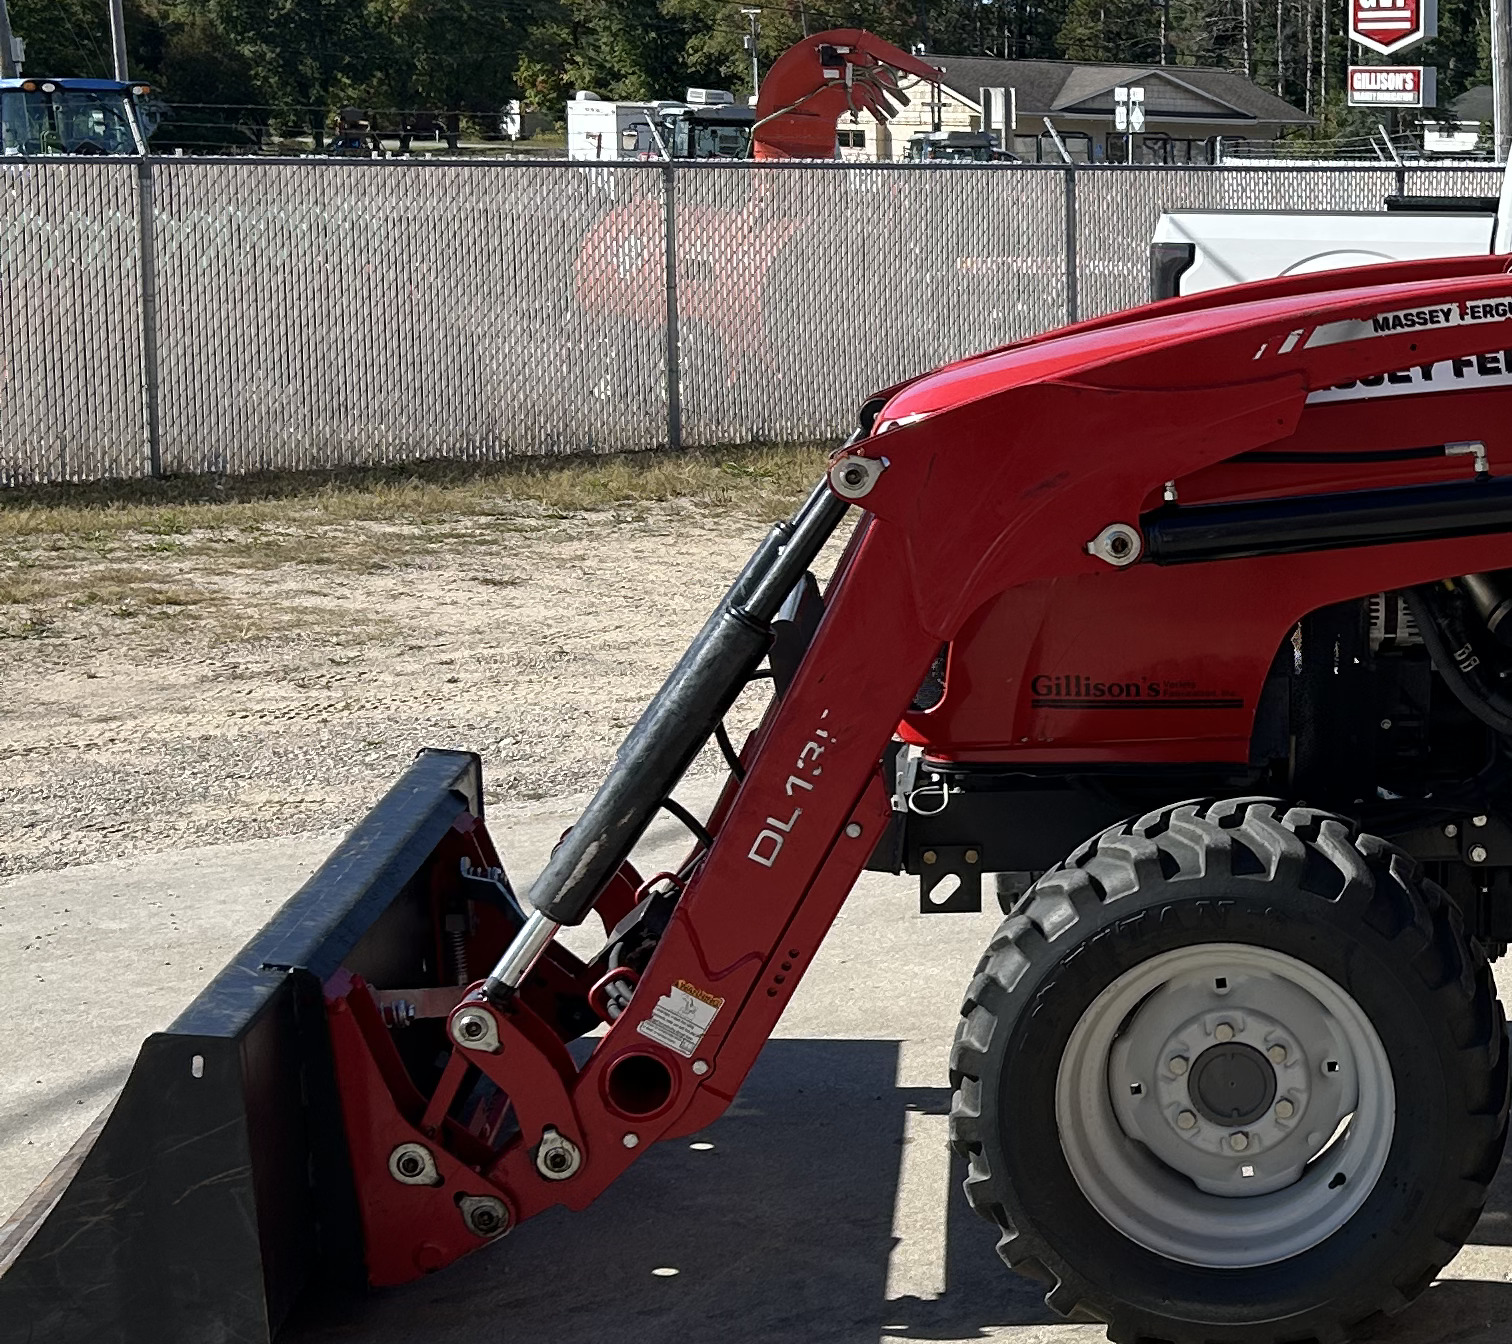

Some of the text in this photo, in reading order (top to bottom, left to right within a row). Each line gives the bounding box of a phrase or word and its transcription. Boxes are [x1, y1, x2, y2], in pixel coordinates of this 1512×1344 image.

[1352, 72, 1414, 91] GILLISON'S
[1372, 307, 1453, 333] MASSEY
[1031, 674, 1161, 698] Gillison's
